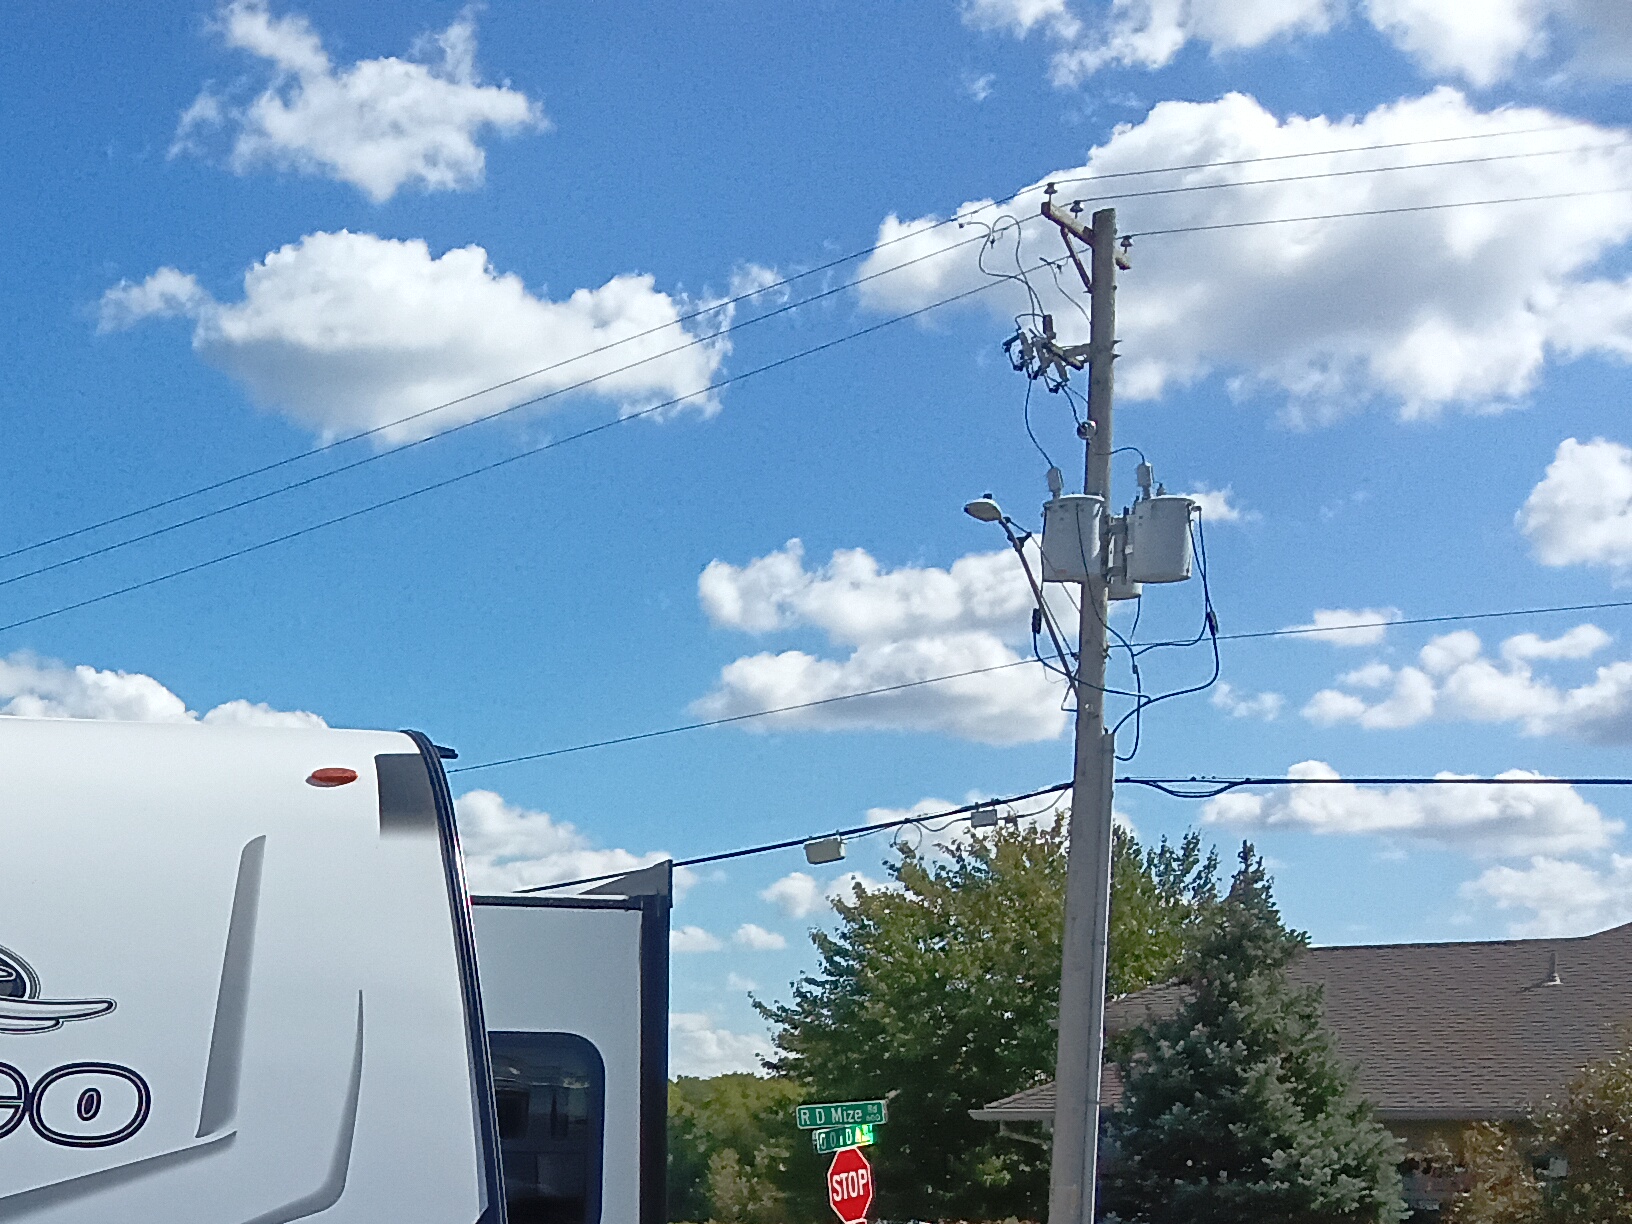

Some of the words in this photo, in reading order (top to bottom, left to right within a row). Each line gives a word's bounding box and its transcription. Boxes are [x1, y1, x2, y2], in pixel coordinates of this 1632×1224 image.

[800, 1109, 811, 1125] R
[816, 1108, 826, 1124] D
[831, 1107, 863, 1123] Mize
[832, 1168, 868, 1202] STOP
